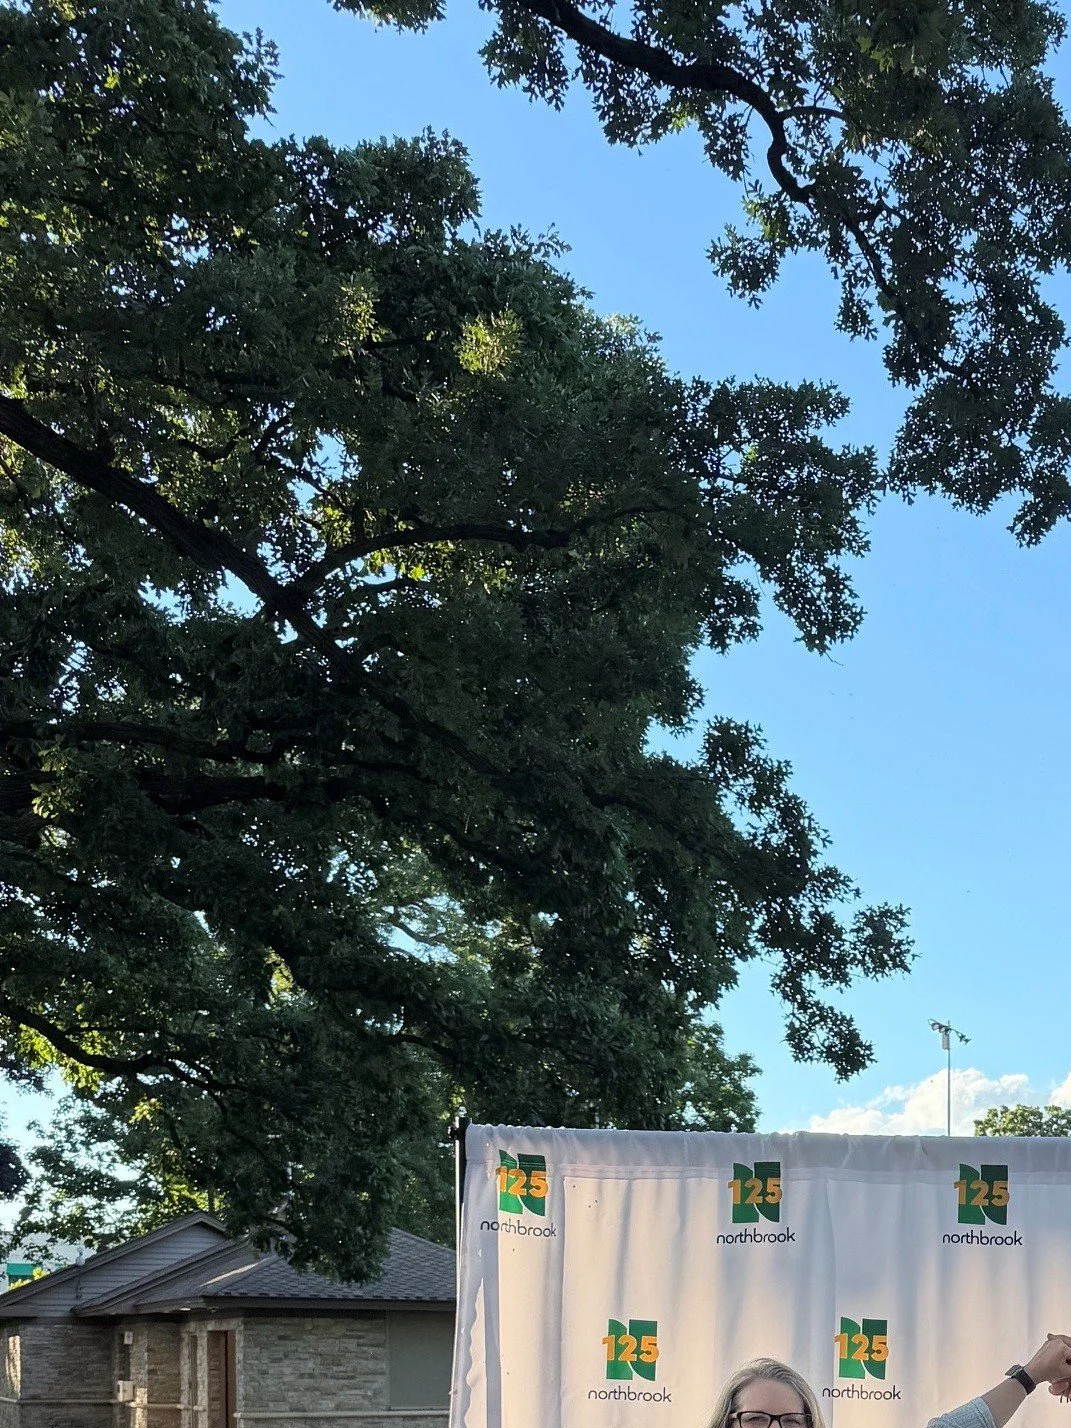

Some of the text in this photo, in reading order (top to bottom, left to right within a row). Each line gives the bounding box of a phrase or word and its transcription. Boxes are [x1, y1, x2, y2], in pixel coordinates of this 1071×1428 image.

[496, 1166, 548, 1198] 125
[728, 1177, 782, 1204] 125
[954, 1179, 1009, 1206] 125
[480, 1217, 557, 1238] northbrook
[716, 1228, 795, 1245] northbrook
[942, 1229, 1022, 1246] northbrook
[603, 1335, 659, 1363] 125
[835, 1333, 888, 1362] 125
[588, 1385, 672, 1403] northbrook
[822, 1384, 901, 1401] northbrook
